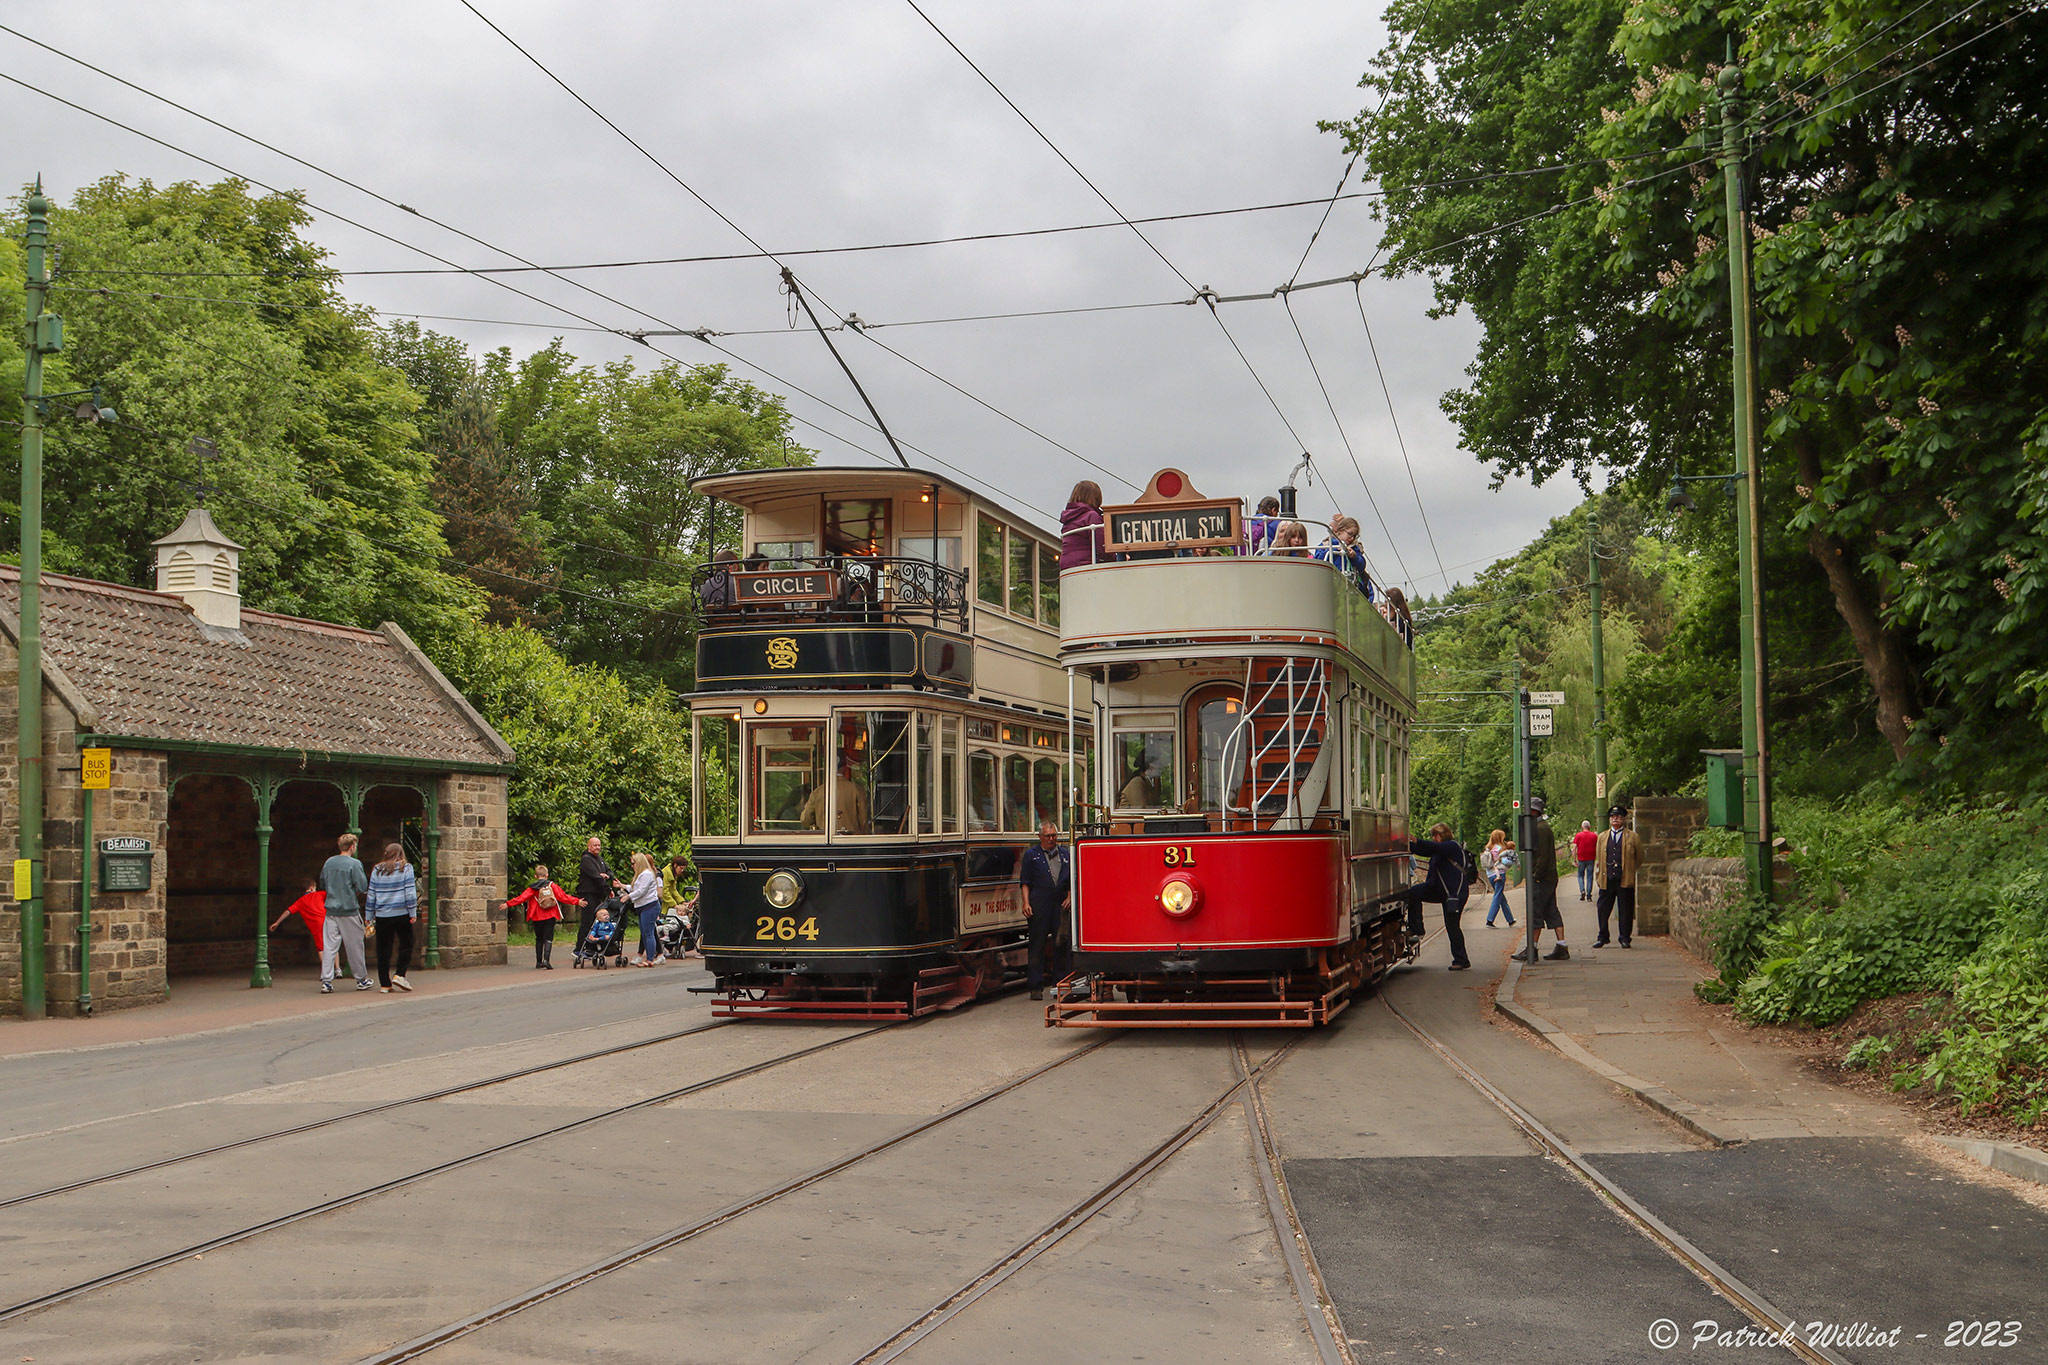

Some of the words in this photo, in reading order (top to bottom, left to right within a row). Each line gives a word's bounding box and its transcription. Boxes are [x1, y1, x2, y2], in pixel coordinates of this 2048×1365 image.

[1121, 518, 1193, 544] CENTRAL
[1198, 515, 1224, 540] STN
[753, 577, 814, 595] CIRCLE
[88, 760, 105, 769] BUS
[85, 770, 107, 779] STOP
[107, 839, 146, 850] BEAMISH
[1164, 846, 1197, 868] 31
[755, 916, 820, 942] 264
